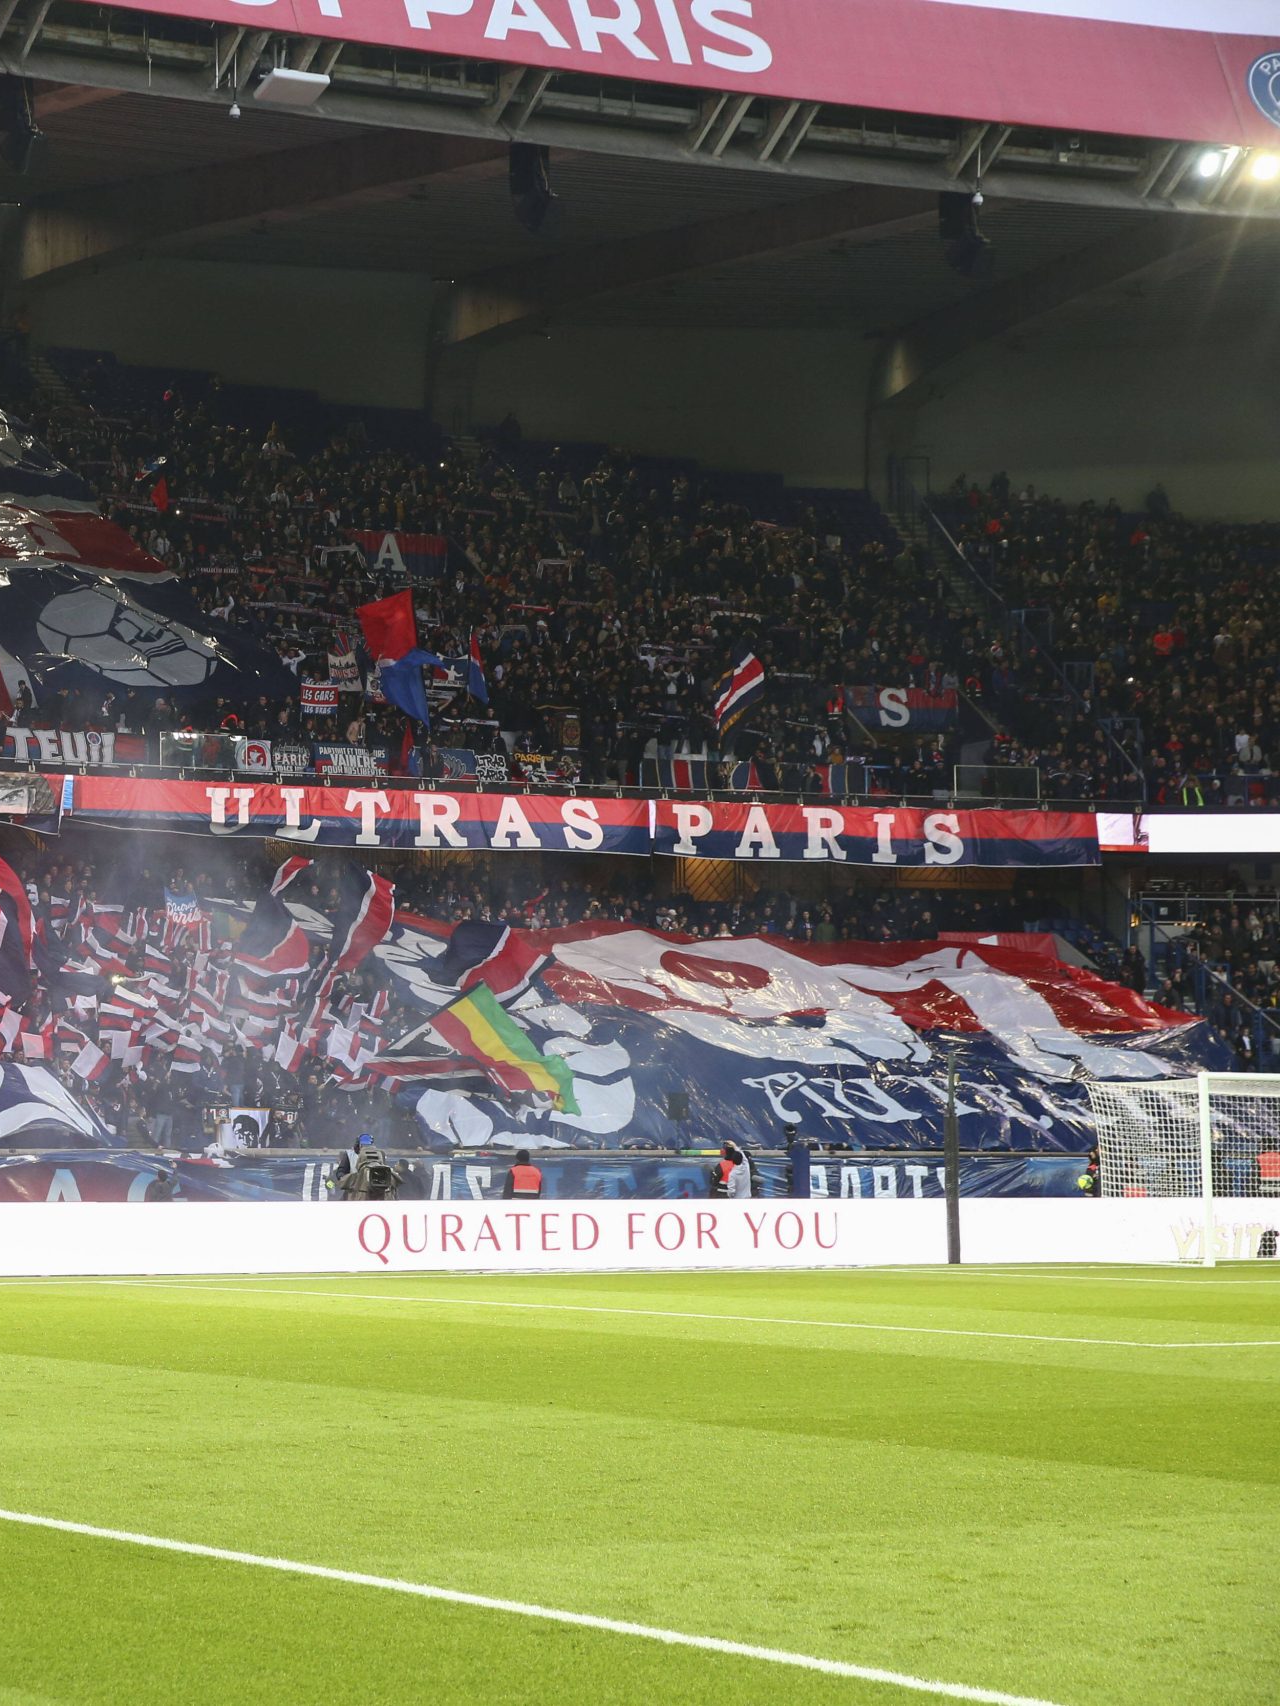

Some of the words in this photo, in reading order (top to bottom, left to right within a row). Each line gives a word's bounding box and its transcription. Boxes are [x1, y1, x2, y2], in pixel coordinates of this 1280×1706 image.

[374, 533, 406, 572] A
[314, 690, 335, 702] GARS
[879, 688, 910, 727] S
[274, 753, 308, 765] PARIS
[330, 753, 378, 769] VAINCRE
[206, 786, 605, 851] ULTRAS
[673, 804, 965, 865] PARIS
[357, 1212, 601, 1265] QURATED
[627, 1212, 720, 1251] FOR
[743, 1210, 839, 1251] YOU
